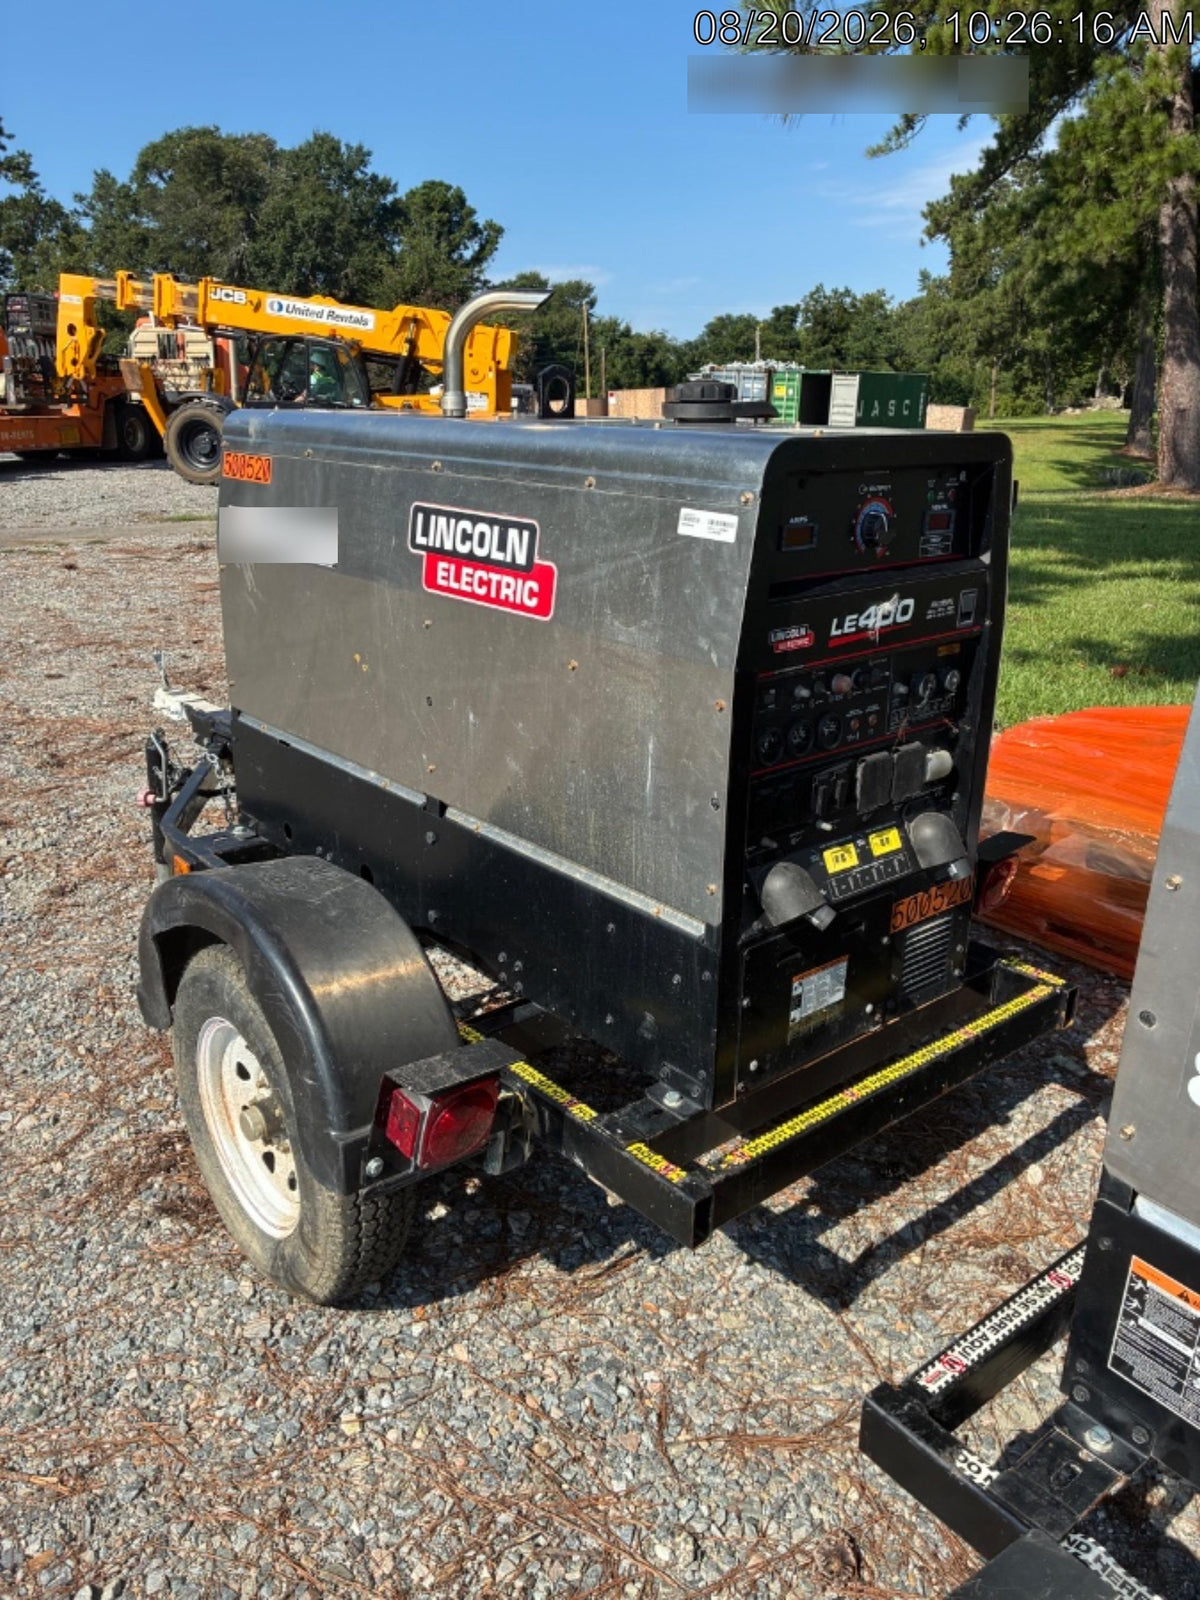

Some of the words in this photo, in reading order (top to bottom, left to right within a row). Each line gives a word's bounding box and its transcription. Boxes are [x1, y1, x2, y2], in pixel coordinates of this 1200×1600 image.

[210, 287, 247, 304] JCB
[285, 303, 323, 319] United
[326, 310, 370, 327] Rentals
[223, 453, 271, 483] 500520
[415, 512, 530, 566] LINCOLN
[436, 561, 540, 608] ELECTRIC
[829, 598, 915, 636] LE400
[770, 626, 807, 642] LINCOLN
[891, 878, 971, 928] 500520
[1017, 1295, 1037, 1312] SE
[986, 1307, 1022, 1336] PARE
